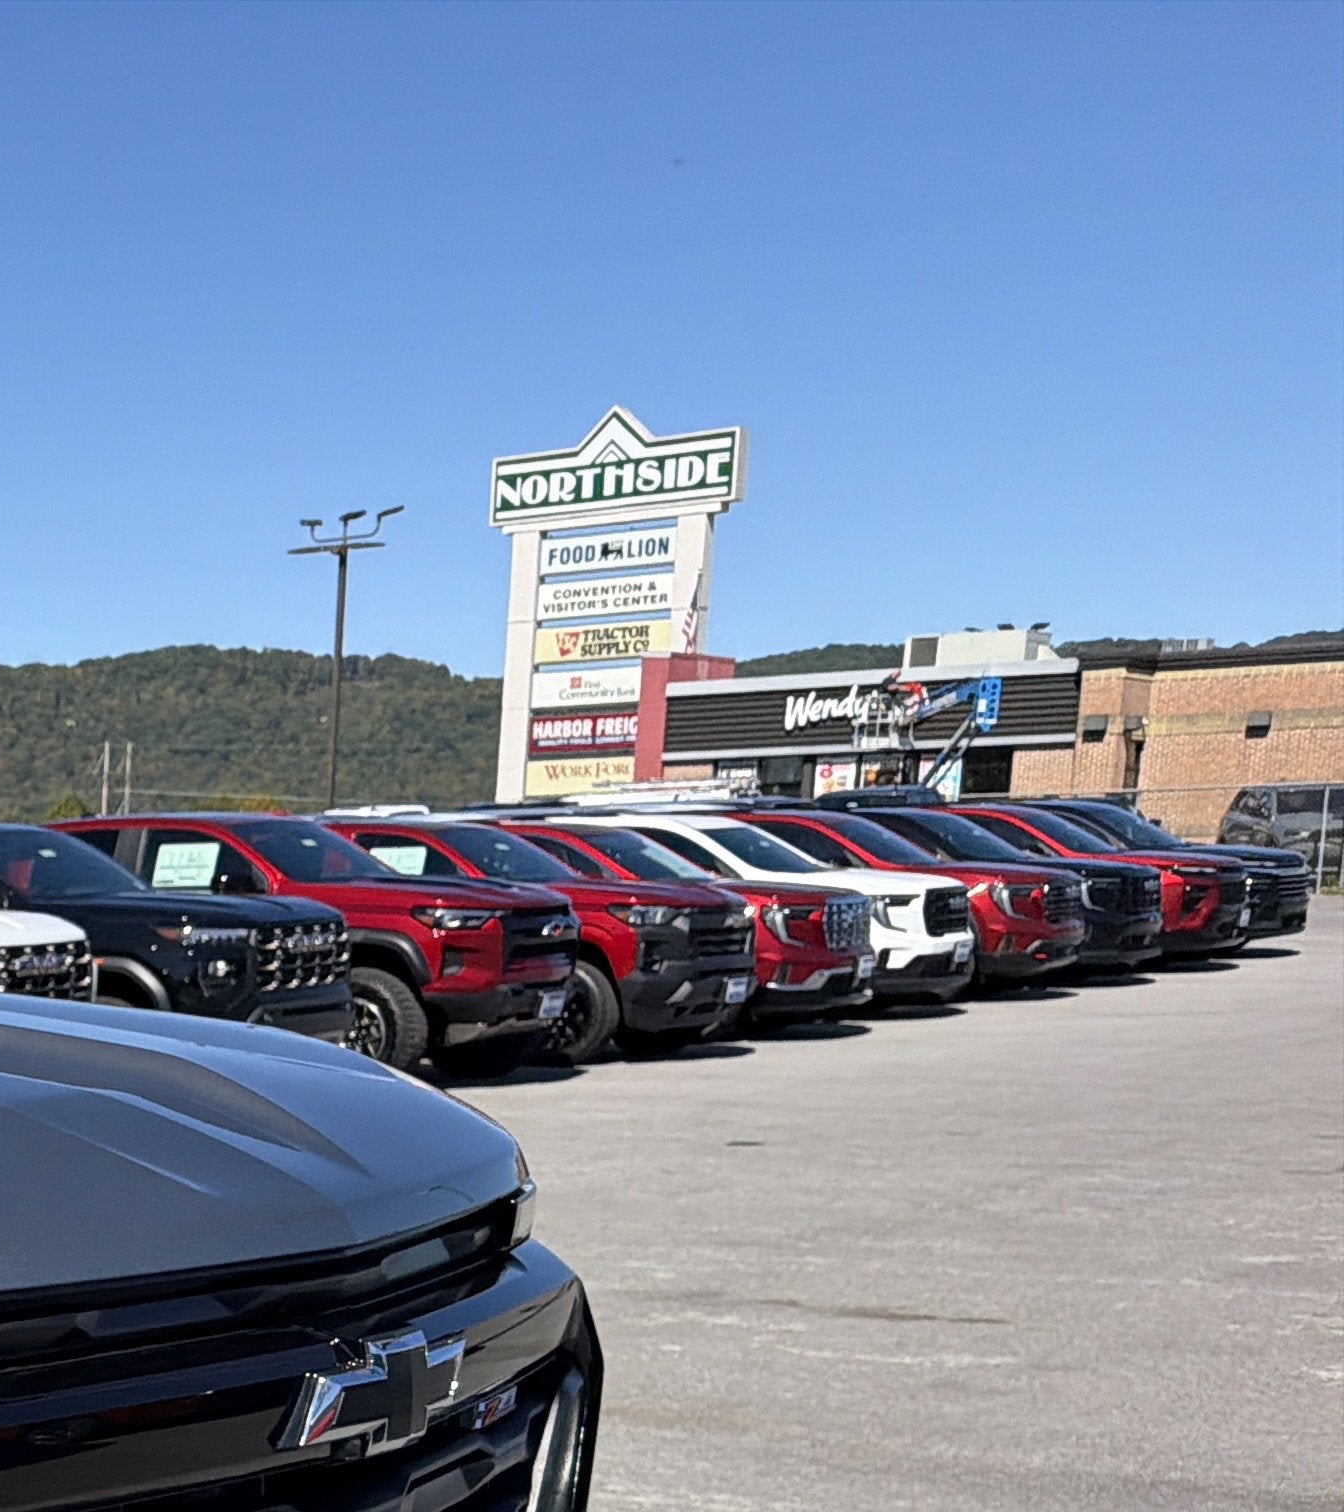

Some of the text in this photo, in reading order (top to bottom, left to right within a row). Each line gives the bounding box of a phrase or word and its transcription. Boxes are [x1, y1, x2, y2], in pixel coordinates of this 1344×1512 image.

[496, 451, 731, 508] NORTHSIDE
[547, 536, 670, 567] FOOD LION
[552, 582, 643, 600] CONVENTION
[542, 592, 669, 614] VISITOR'S CENTER
[581, 625, 650, 642] TRACTOR
[580, 640, 632, 657] SUPPLY
[784, 683, 879, 731] Wendy
[532, 715, 639, 740] HARBOR FREIG
